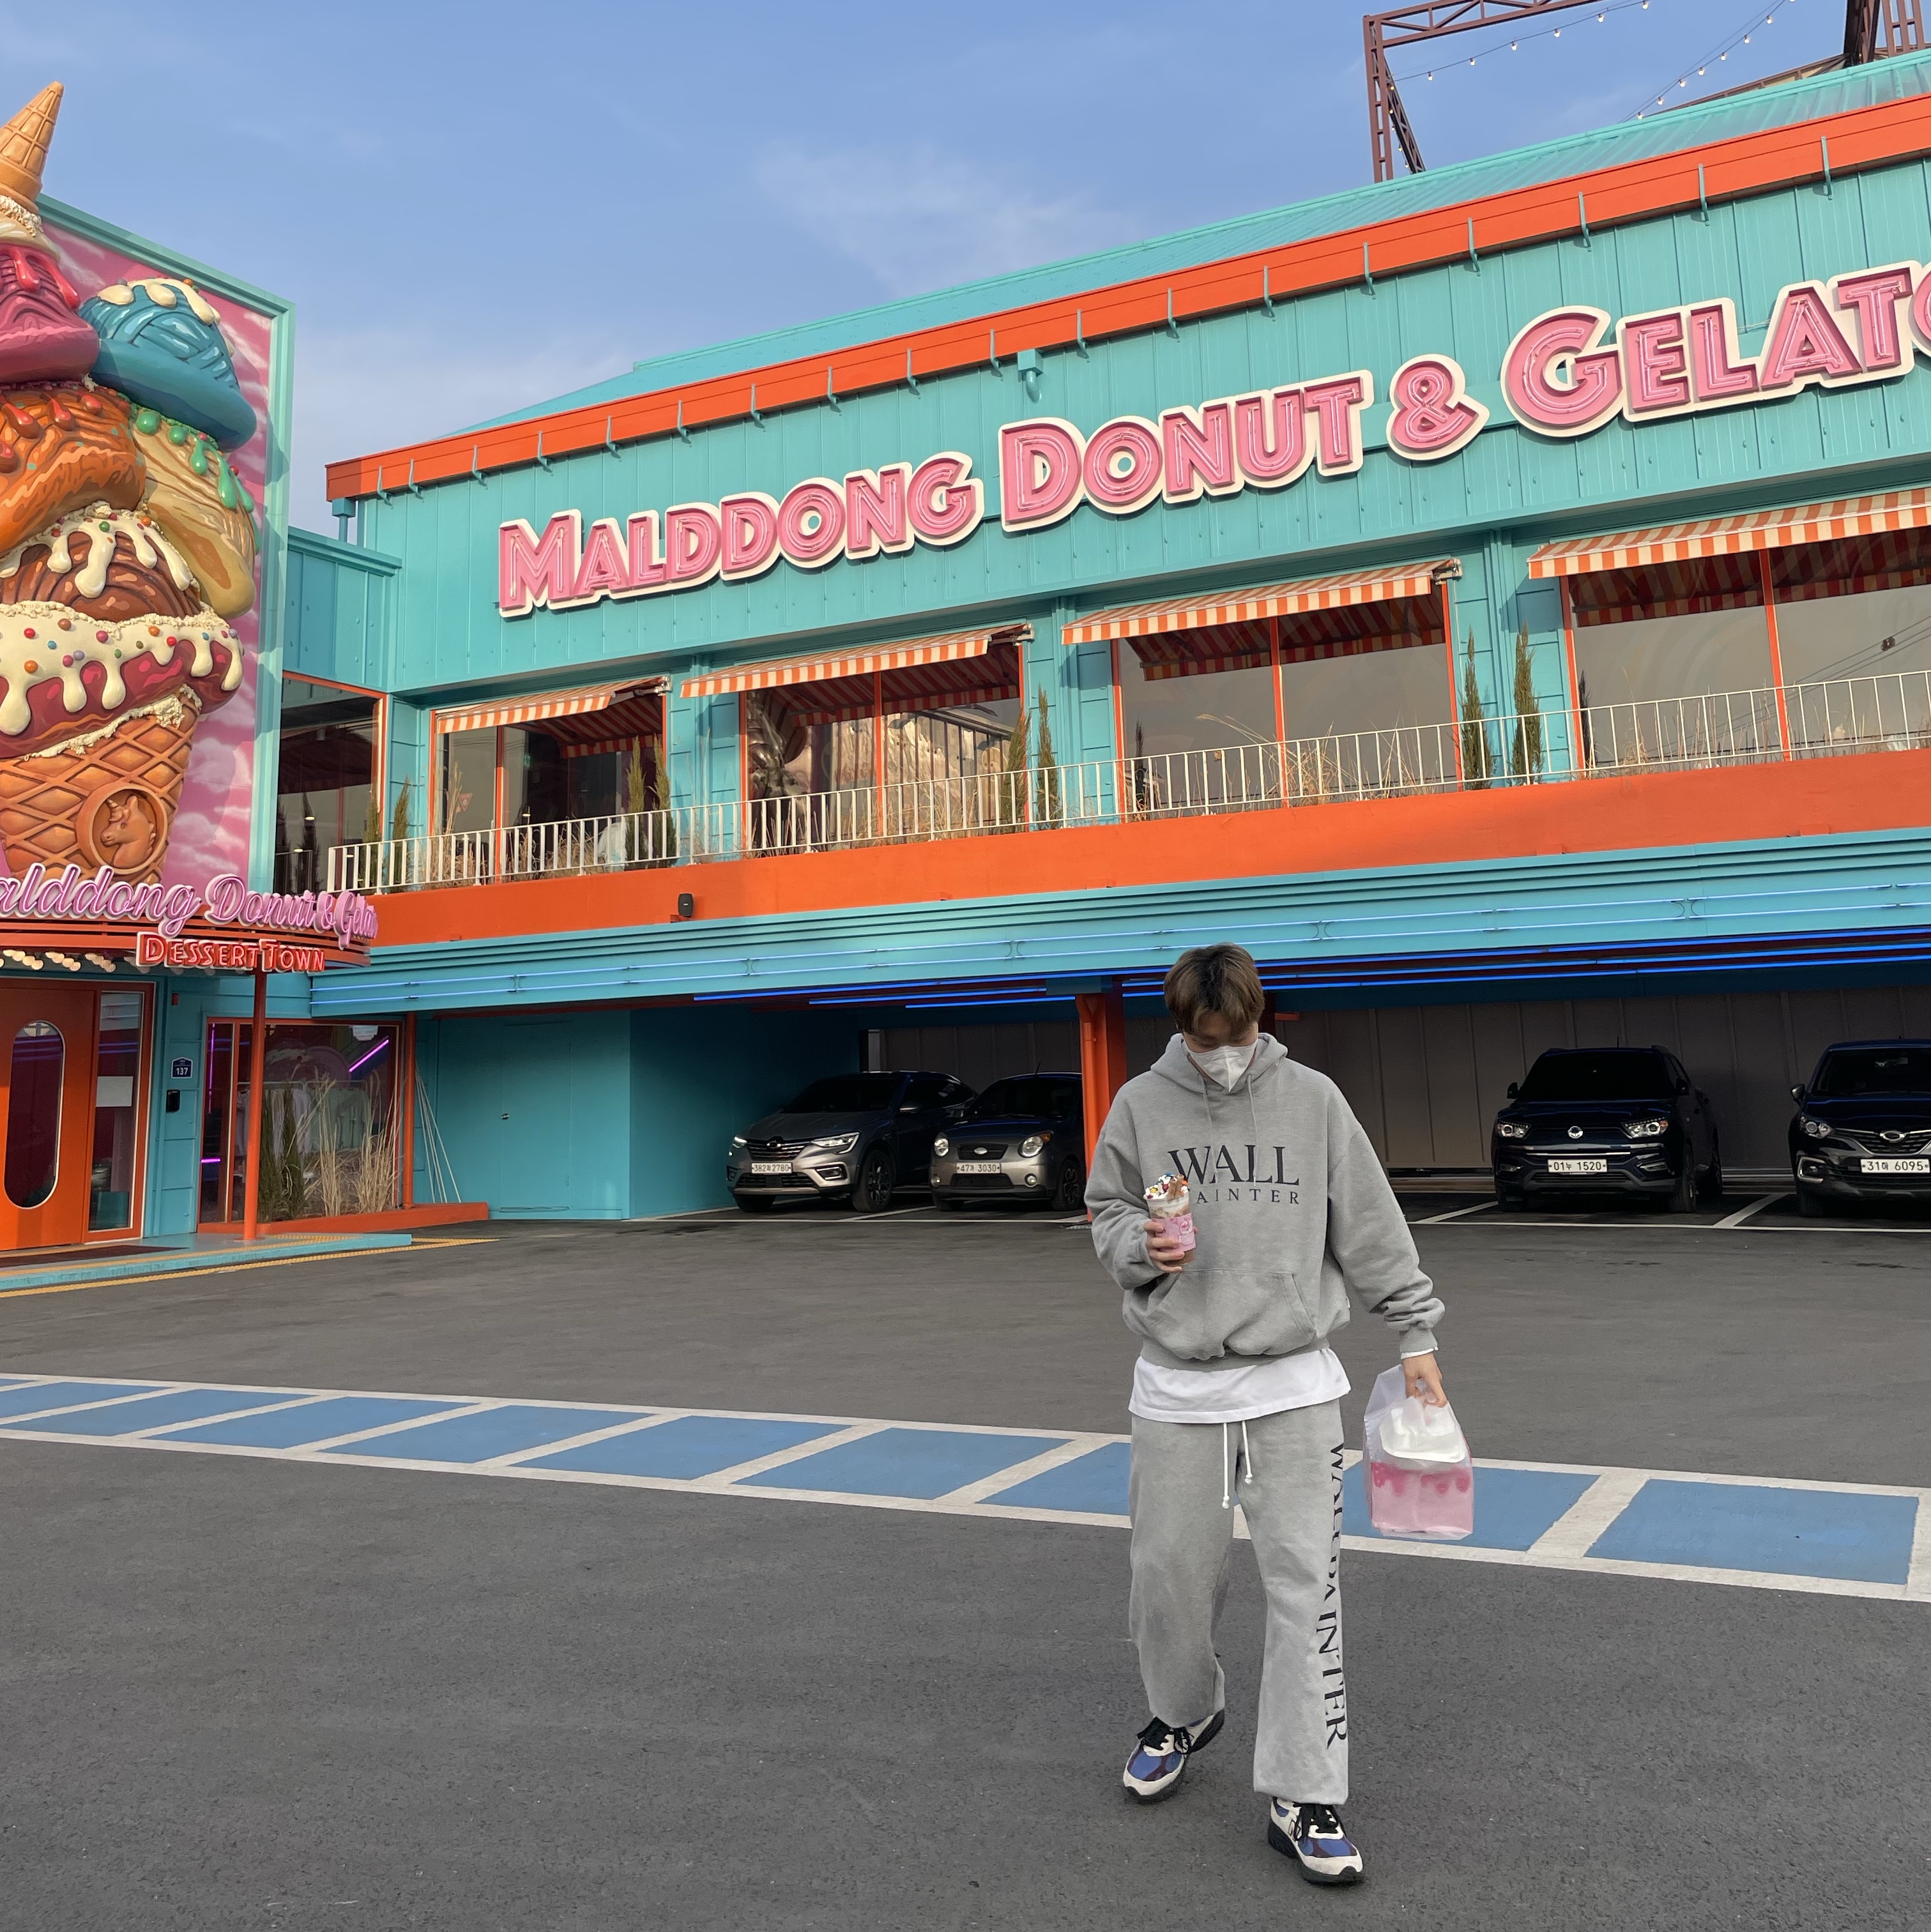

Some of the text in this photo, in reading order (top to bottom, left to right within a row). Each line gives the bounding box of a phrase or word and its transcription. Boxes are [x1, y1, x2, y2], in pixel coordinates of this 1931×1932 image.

[499, 451, 984, 617] MALDDONG
[999, 370, 1372, 532] DONUT
[1386, 354, 1490, 460] &
[204, 874, 317, 931] Donut
[315, 891, 336, 933] &
[136, 932, 325, 973] DESSERT TOWN
[176, 1067, 188, 1076] 137
[977, 1164, 996, 1173] 3030
[1167, 1145, 1299, 1185] WALL
[1576, 1161, 1601, 1171] 1520
[1895, 1160, 1923, 1171] 6095
[1196, 1187, 1299, 1205] AINTER
